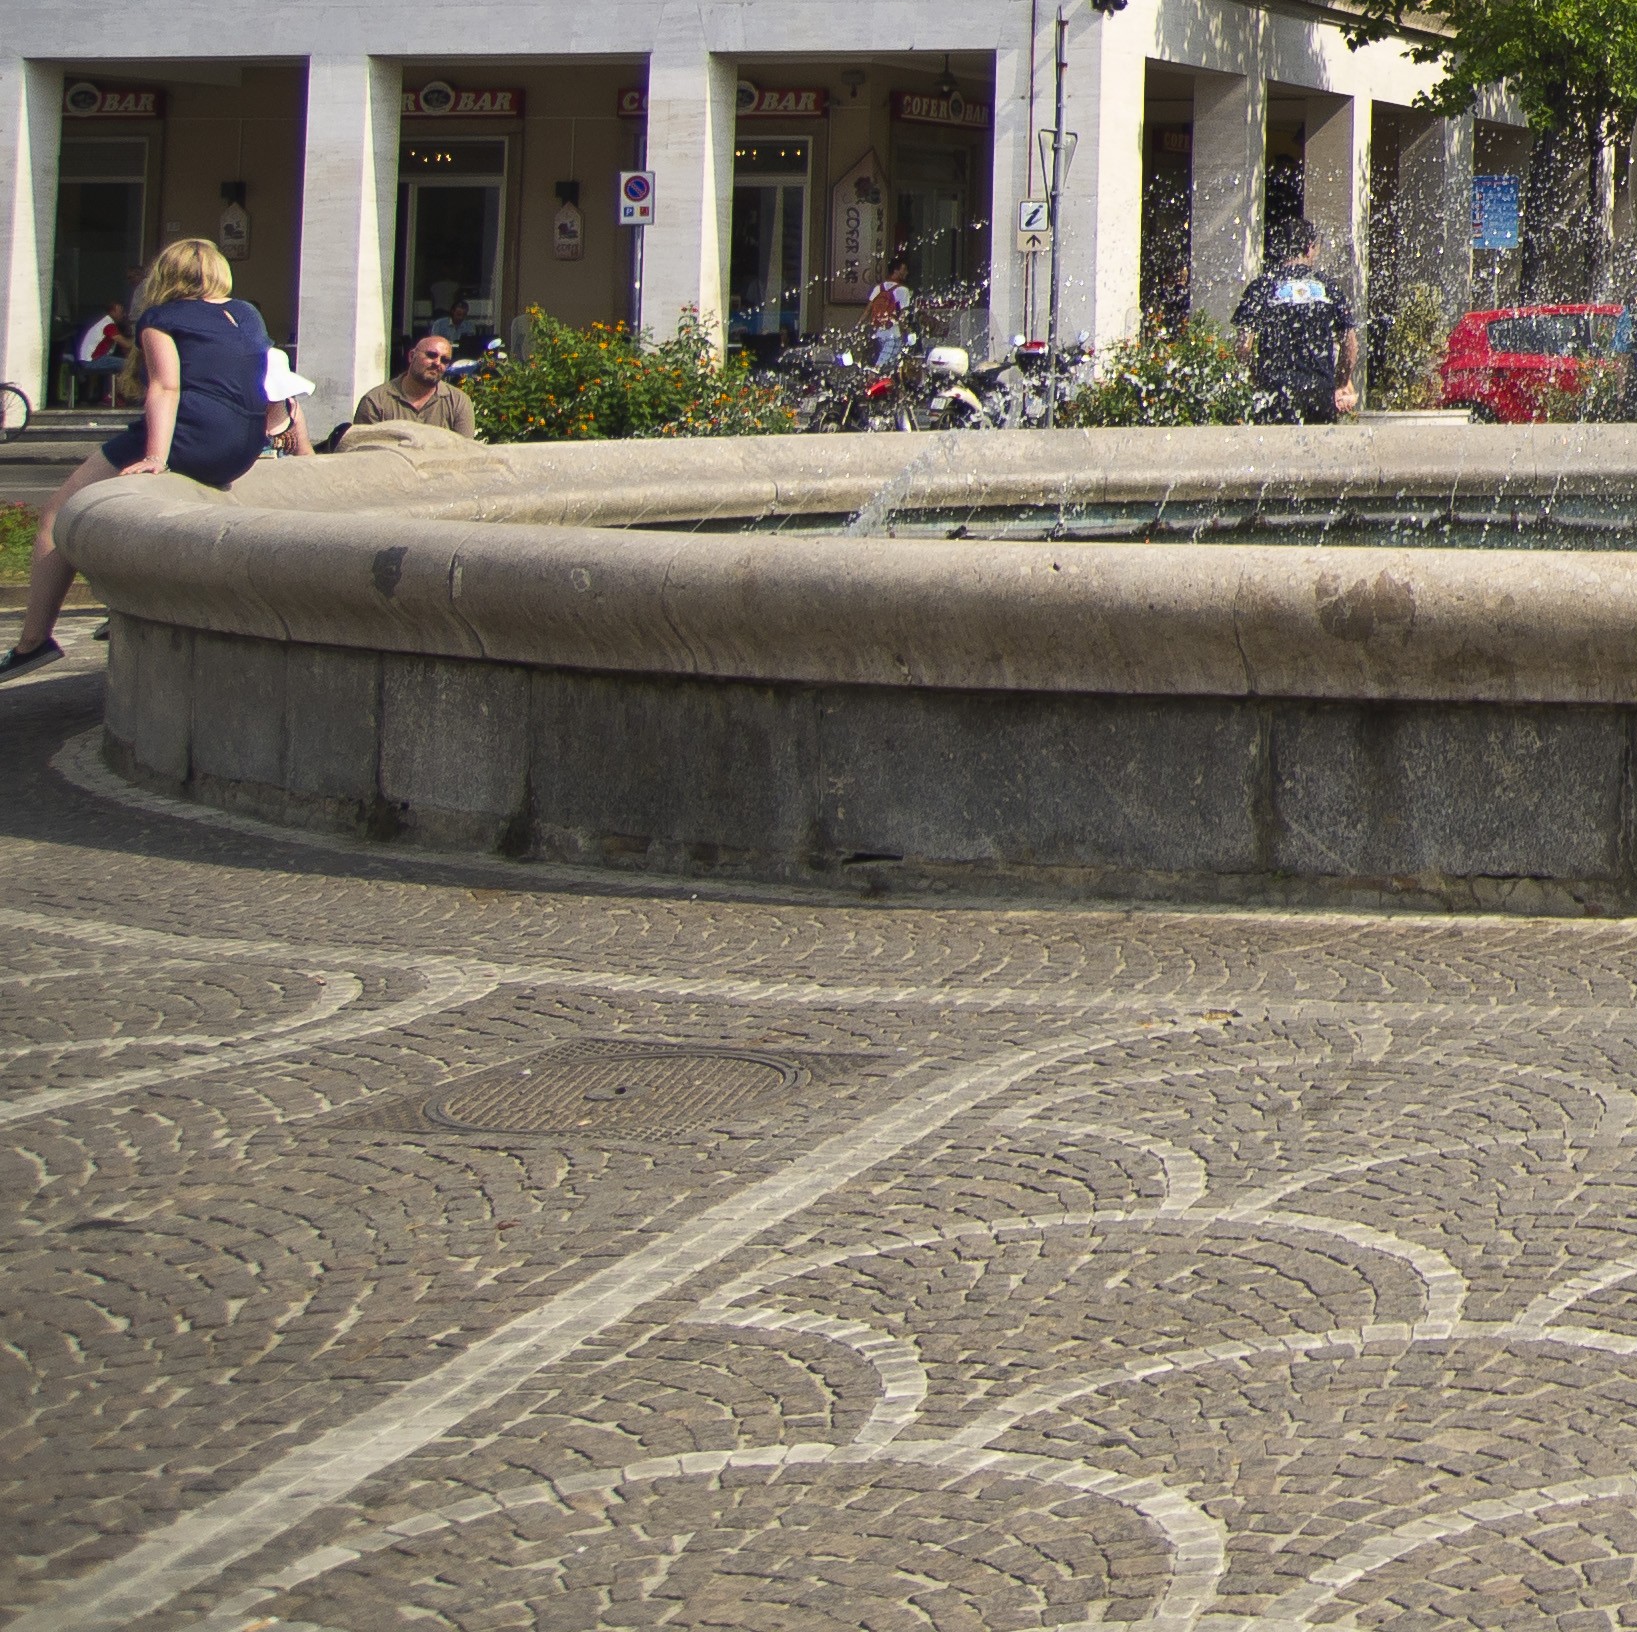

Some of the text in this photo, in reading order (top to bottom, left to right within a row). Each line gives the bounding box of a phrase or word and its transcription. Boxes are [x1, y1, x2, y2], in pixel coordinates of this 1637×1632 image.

[101, 92, 155, 111] BAR
[457, 92, 513, 111] BAR
[759, 92, 817, 111] BAR
[903, 95, 989, 124] COFER BAR
